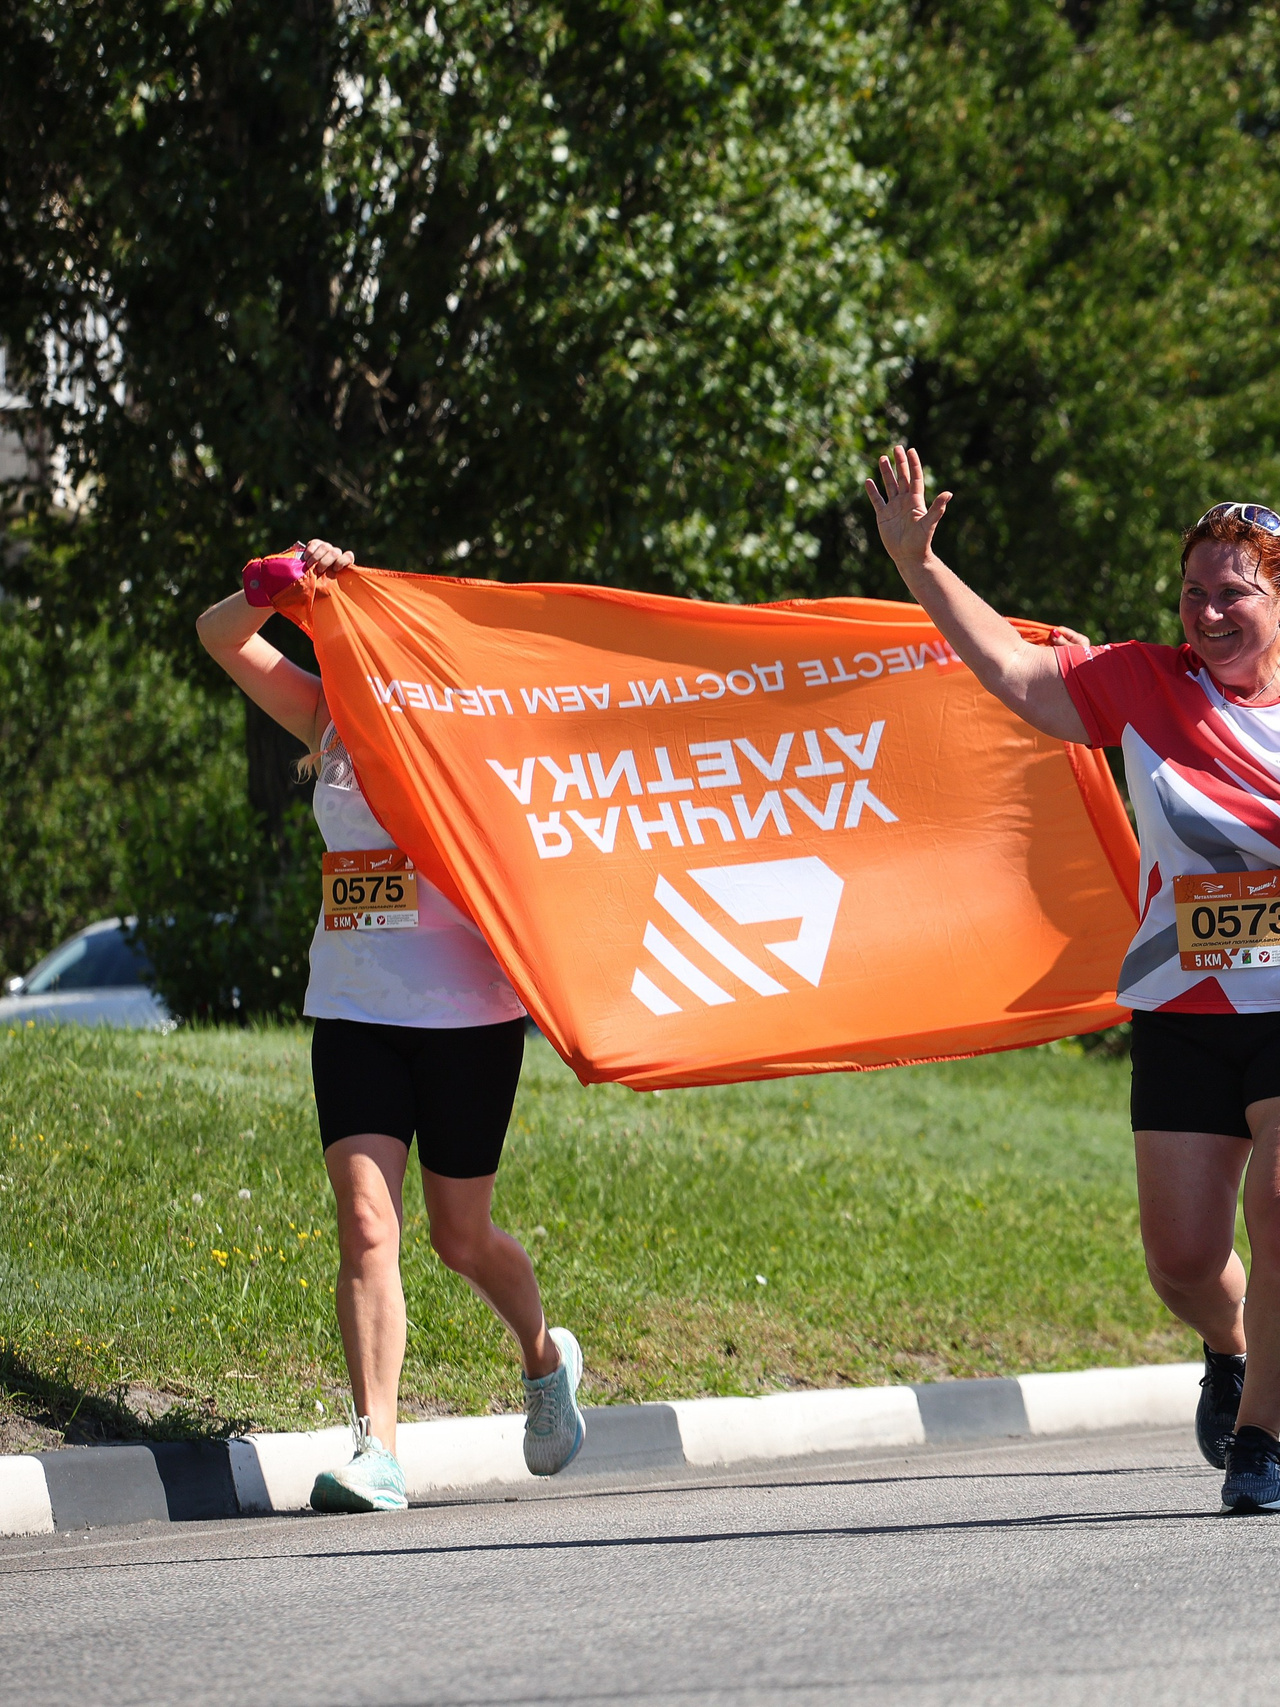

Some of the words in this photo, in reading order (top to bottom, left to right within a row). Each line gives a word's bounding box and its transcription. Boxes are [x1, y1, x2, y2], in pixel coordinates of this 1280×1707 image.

[366, 675, 514, 716] ЦЕЛЕЙ!
[519, 660, 785, 714] ДОСТИГАЕМ
[485, 720, 886, 805] АТЛЕТИКА
[525, 779, 900, 859] УЛИЧНАЯ
[332, 876, 404, 905] 0575
[334, 917, 339, 928] 5
[1195, 955, 1202, 967] 5
